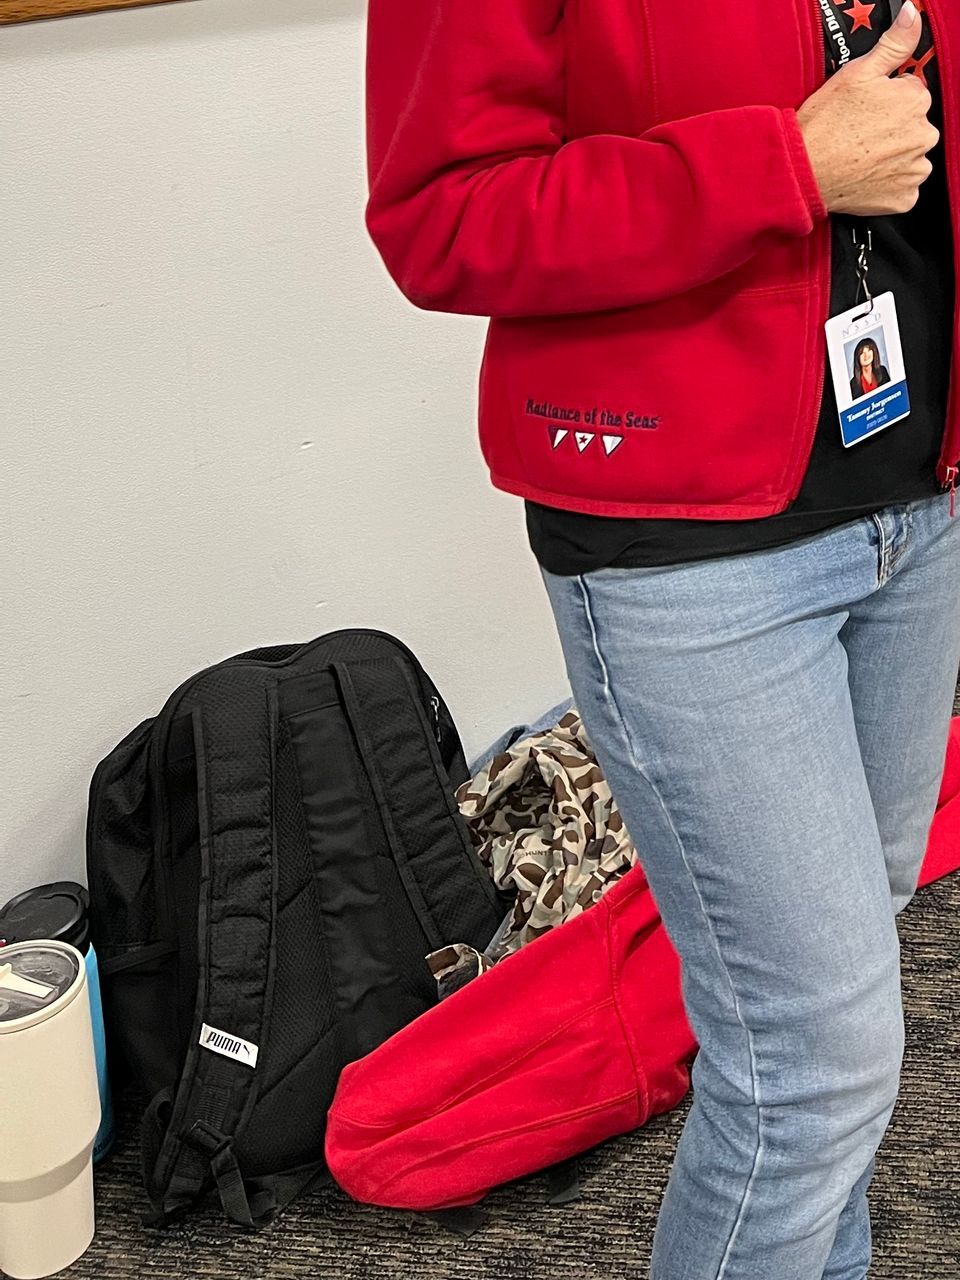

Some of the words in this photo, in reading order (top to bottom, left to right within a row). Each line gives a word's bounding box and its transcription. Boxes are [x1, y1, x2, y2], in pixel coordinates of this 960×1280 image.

[832, 32, 851, 65] hool
[525, 399, 581, 422] Radiance
[584, 408, 598, 425] of
[600, 410, 622, 427] the
[625, 412, 660, 430] Seas
[206, 1031, 242, 1054] PUMA
